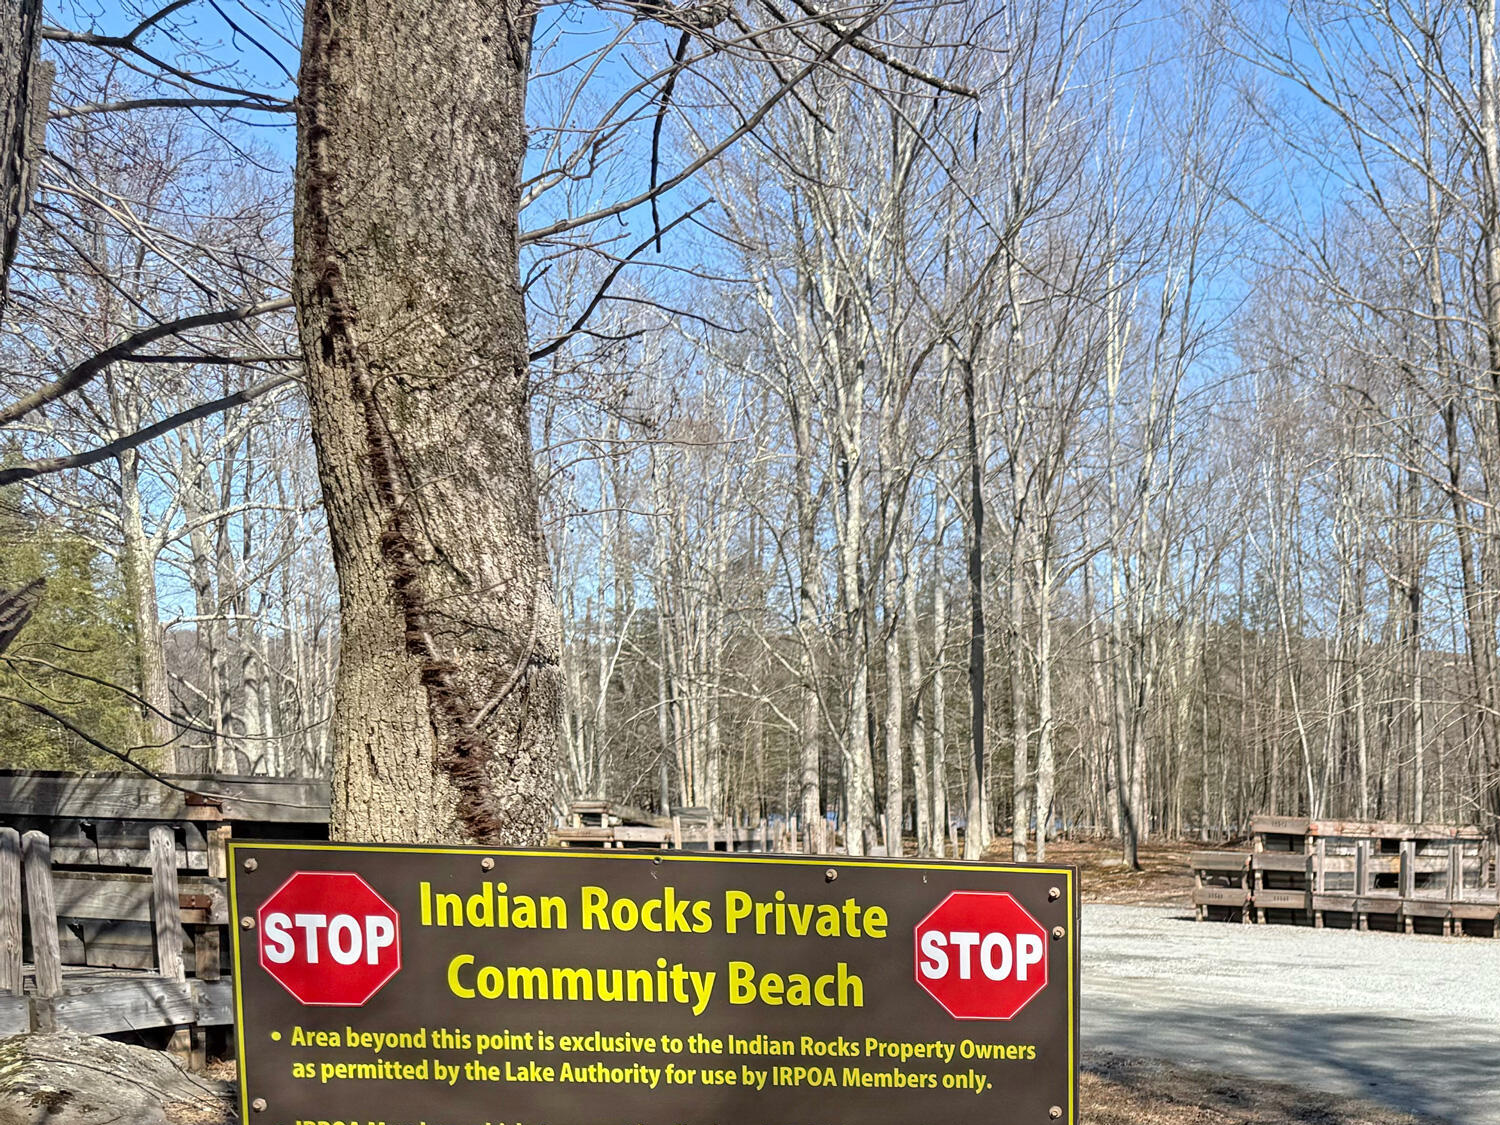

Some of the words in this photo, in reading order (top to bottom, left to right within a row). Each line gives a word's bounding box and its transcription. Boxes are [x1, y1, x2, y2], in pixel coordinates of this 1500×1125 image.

[420, 881, 567, 929] Indian
[581, 886, 712, 933] Rocks
[726, 890, 888, 938] Private
[265, 913, 395, 965] STOP
[920, 931, 1044, 981] STOP
[448, 954, 716, 1016] Community
[729, 961, 863, 1007] Beach
[291, 1026, 340, 1047] Area
[346, 1027, 426, 1053] beyond
[431, 1029, 471, 1049] this
[477, 1030, 533, 1054] point
[538, 1031, 555, 1051] is
[559, 1032, 656, 1053] exclusive
[661, 1035, 683, 1053] to
[687, 1034, 723, 1054] the
[729, 1035, 794, 1055] Indian
[801, 1036, 860, 1056] Rocks
[865, 1038, 955, 1063] Property
[960, 1040, 1035, 1060] Owners
[292, 1063, 316, 1078] as
[321, 1059, 428, 1083] permitted
[434, 1060, 460, 1086] by
[464, 1060, 500, 1081] the
[505, 1061, 555, 1082] Lake
[560, 1062, 661, 1088] Authority
[665, 1064, 696, 1084] for
[701, 1070, 737, 1085] use
[742, 1065, 767, 1090] by
[773, 1067, 837, 1086] IRPOA
[843, 1068, 937, 1088] Members
[942, 1069, 991, 1094] only.
